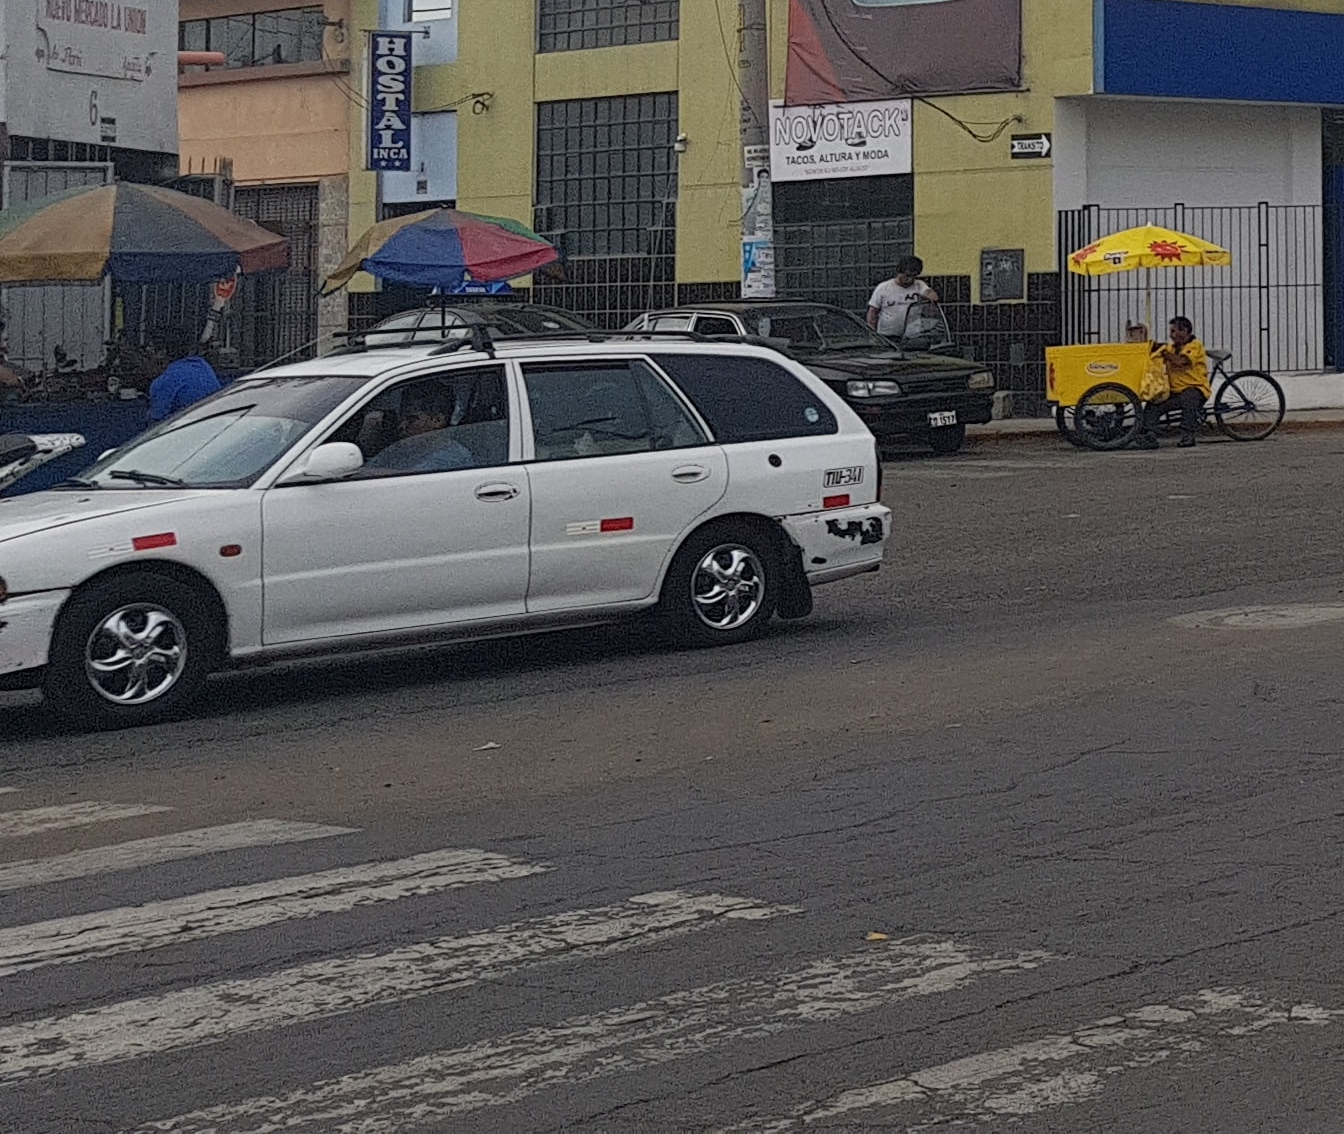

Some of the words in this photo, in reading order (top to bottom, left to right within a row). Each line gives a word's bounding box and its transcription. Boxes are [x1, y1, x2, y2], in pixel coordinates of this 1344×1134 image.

[111, 2, 122, 30] LA
[375, 37, 407, 148] HOSTAL
[775, 108, 900, 146] NOVOTACK
[373, 149, 408, 159] INCA
[785, 155, 817, 165] TACOS,
[820, 152, 853, 163] ALTURA
[855, 151, 861, 161] Y
[863, 150, 889, 160] MODA
